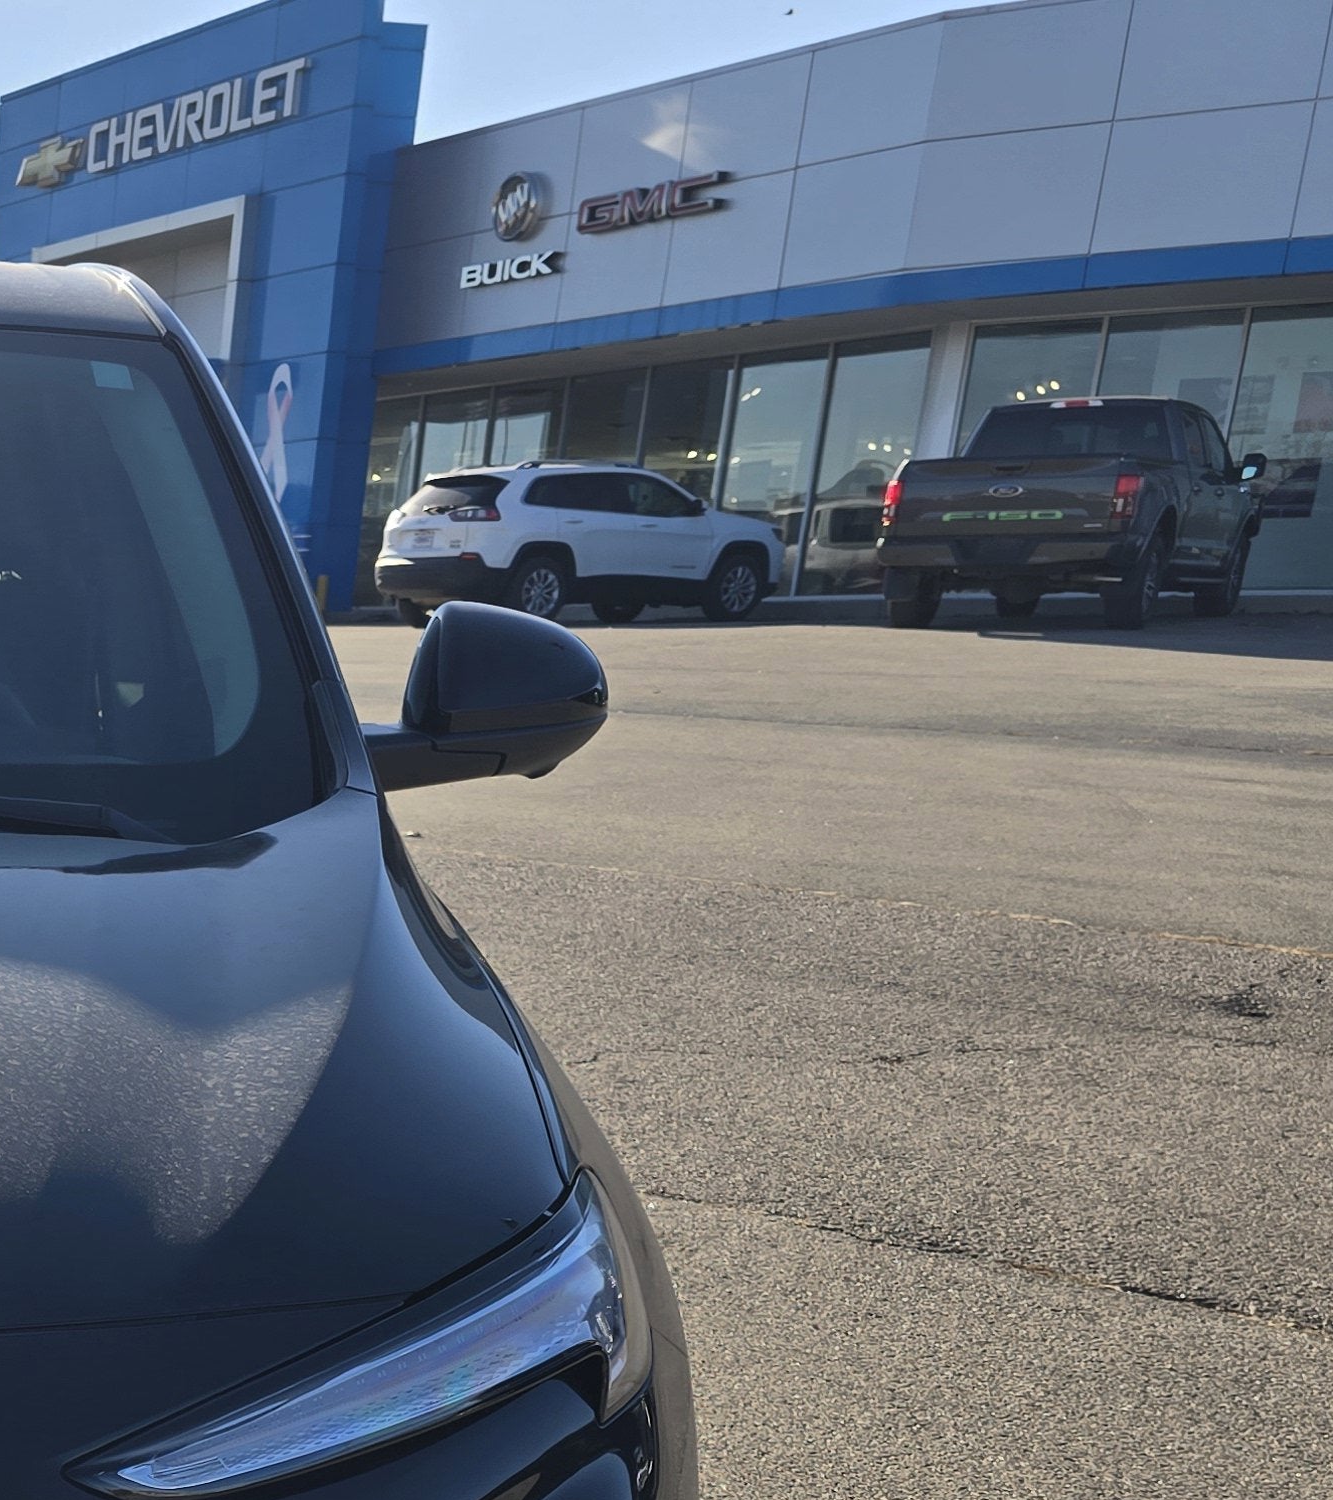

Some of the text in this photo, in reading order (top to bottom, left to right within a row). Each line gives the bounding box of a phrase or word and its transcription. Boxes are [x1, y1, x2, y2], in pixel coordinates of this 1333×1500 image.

[87, 57, 306, 174] CHEVROLET
[577, 170, 723, 234] GMC
[459, 250, 555, 289] BUICK
[942, 510, 1063, 521] F-150
